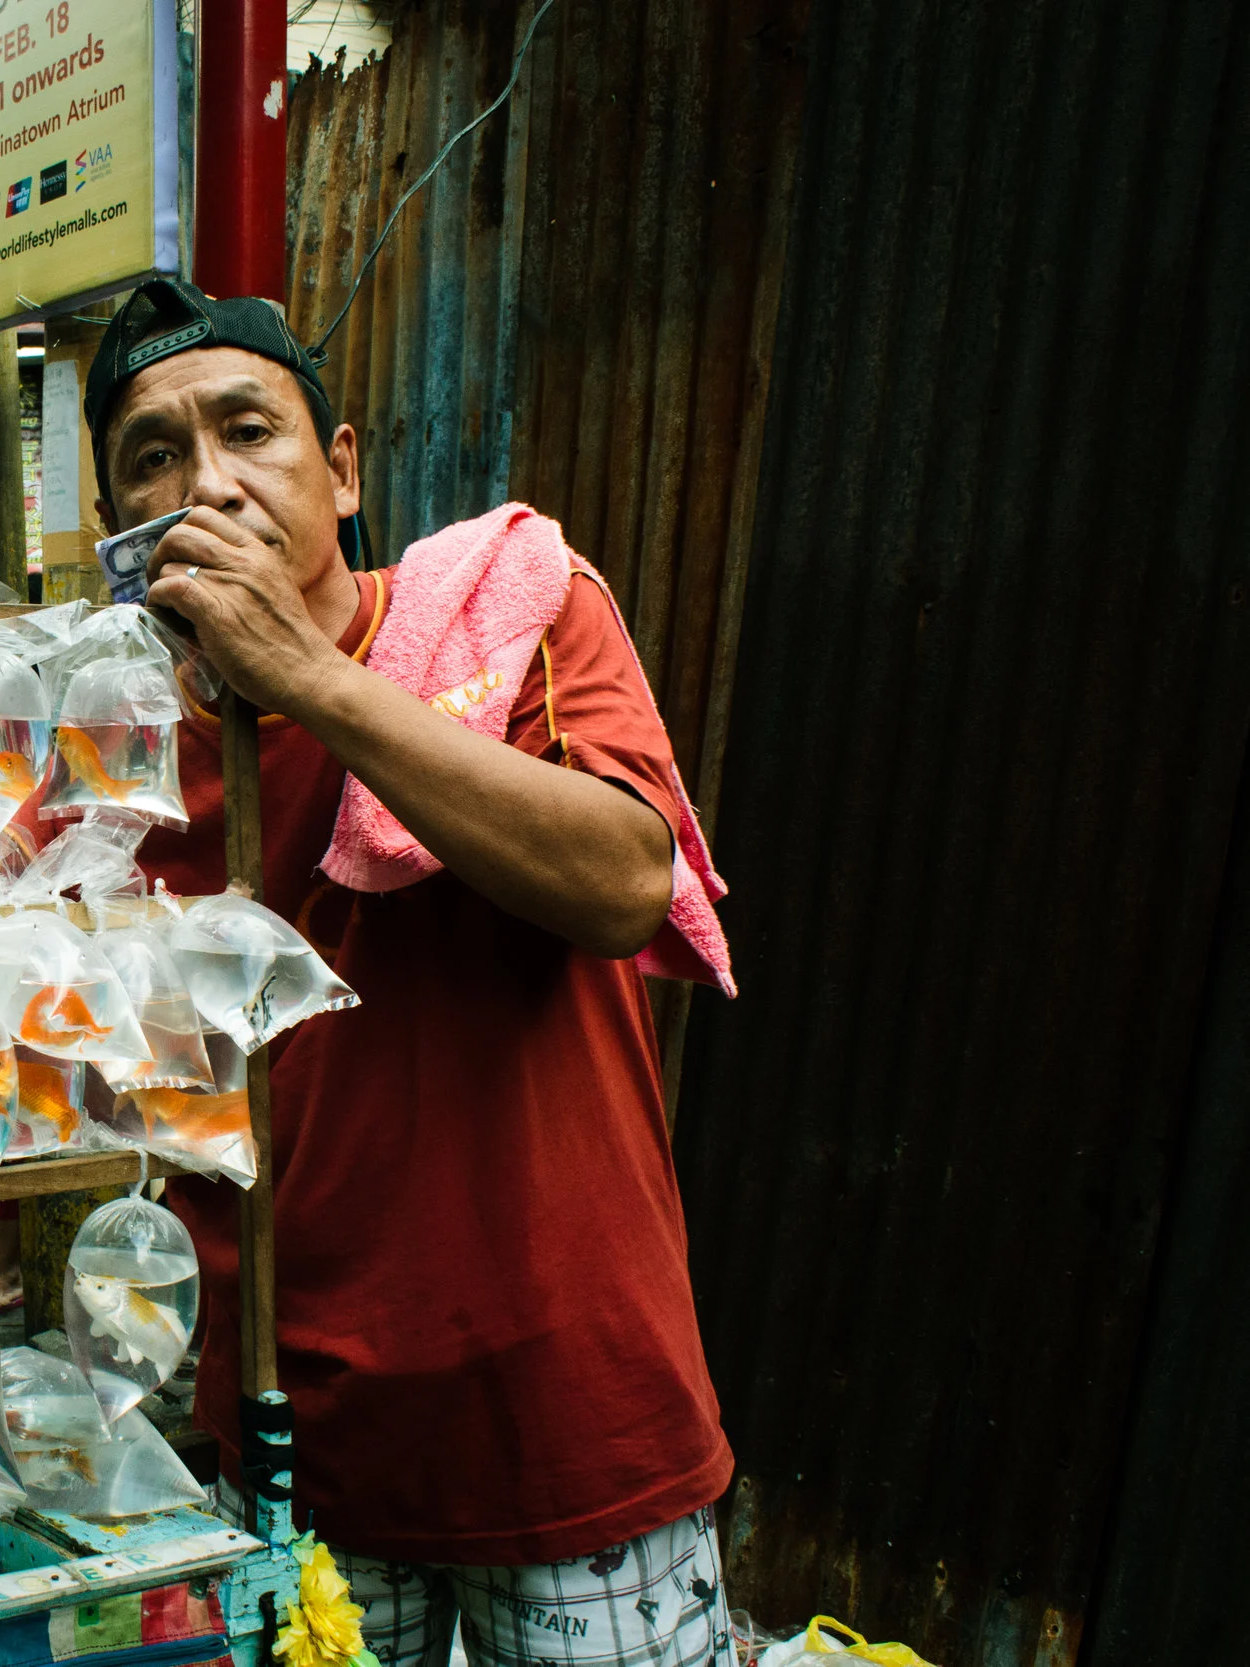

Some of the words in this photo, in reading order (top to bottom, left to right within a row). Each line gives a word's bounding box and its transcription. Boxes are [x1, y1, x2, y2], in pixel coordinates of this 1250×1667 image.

[45, 0, 70, 39] 18
[12, 33, 105, 104] onwards
[66, 84, 126, 126] Atrium
